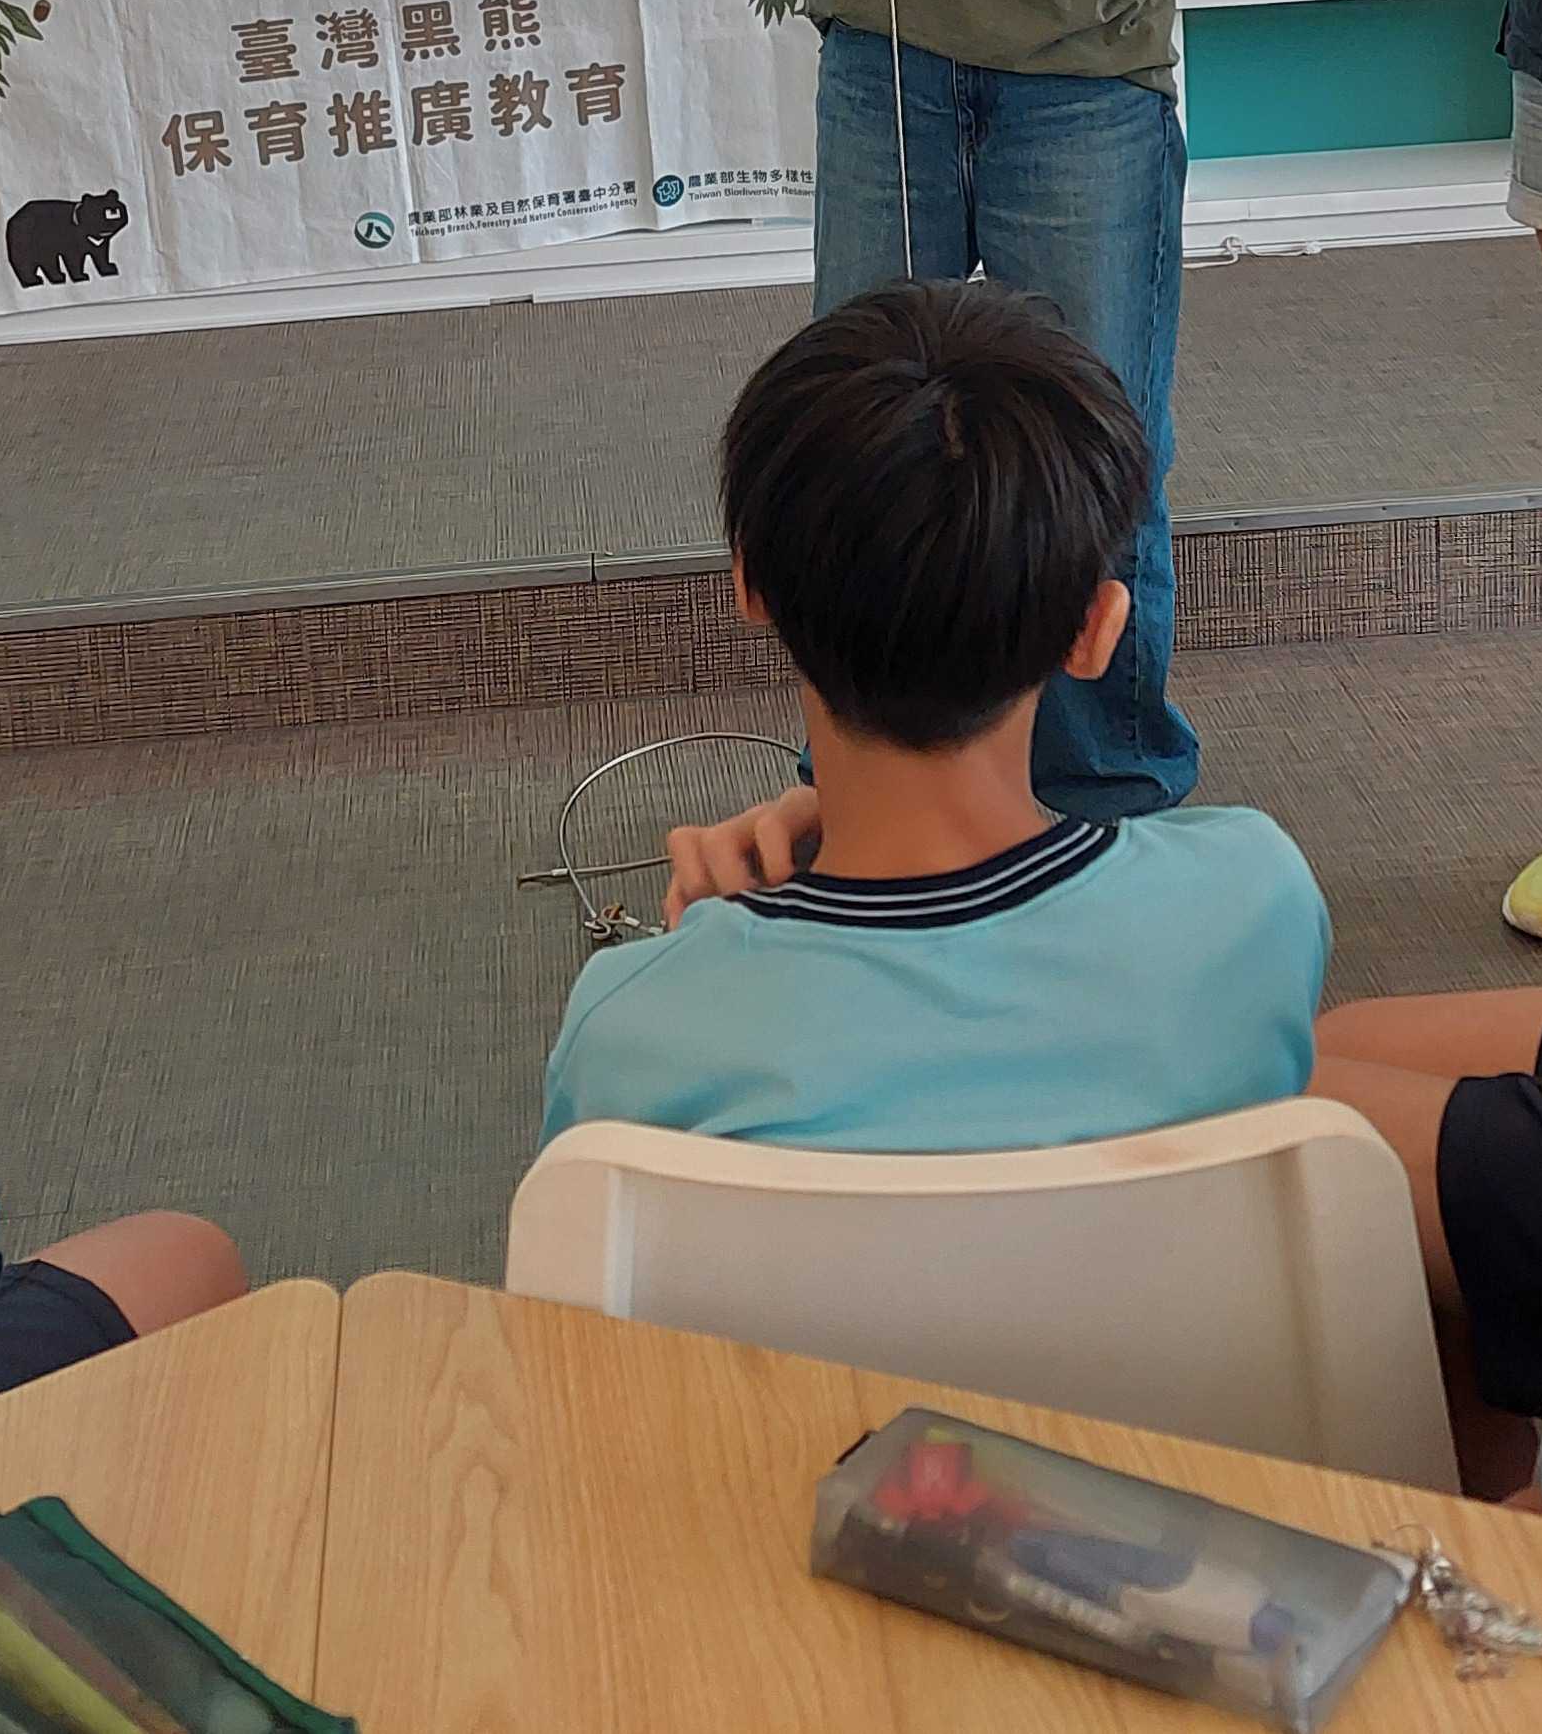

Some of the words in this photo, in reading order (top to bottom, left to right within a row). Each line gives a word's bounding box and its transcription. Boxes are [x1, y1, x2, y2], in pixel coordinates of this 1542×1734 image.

[161, 62, 628, 177] 保育推廣教育
[688, 190, 722, 202] Taiwan
[724, 187, 779, 198] Biodiversity
